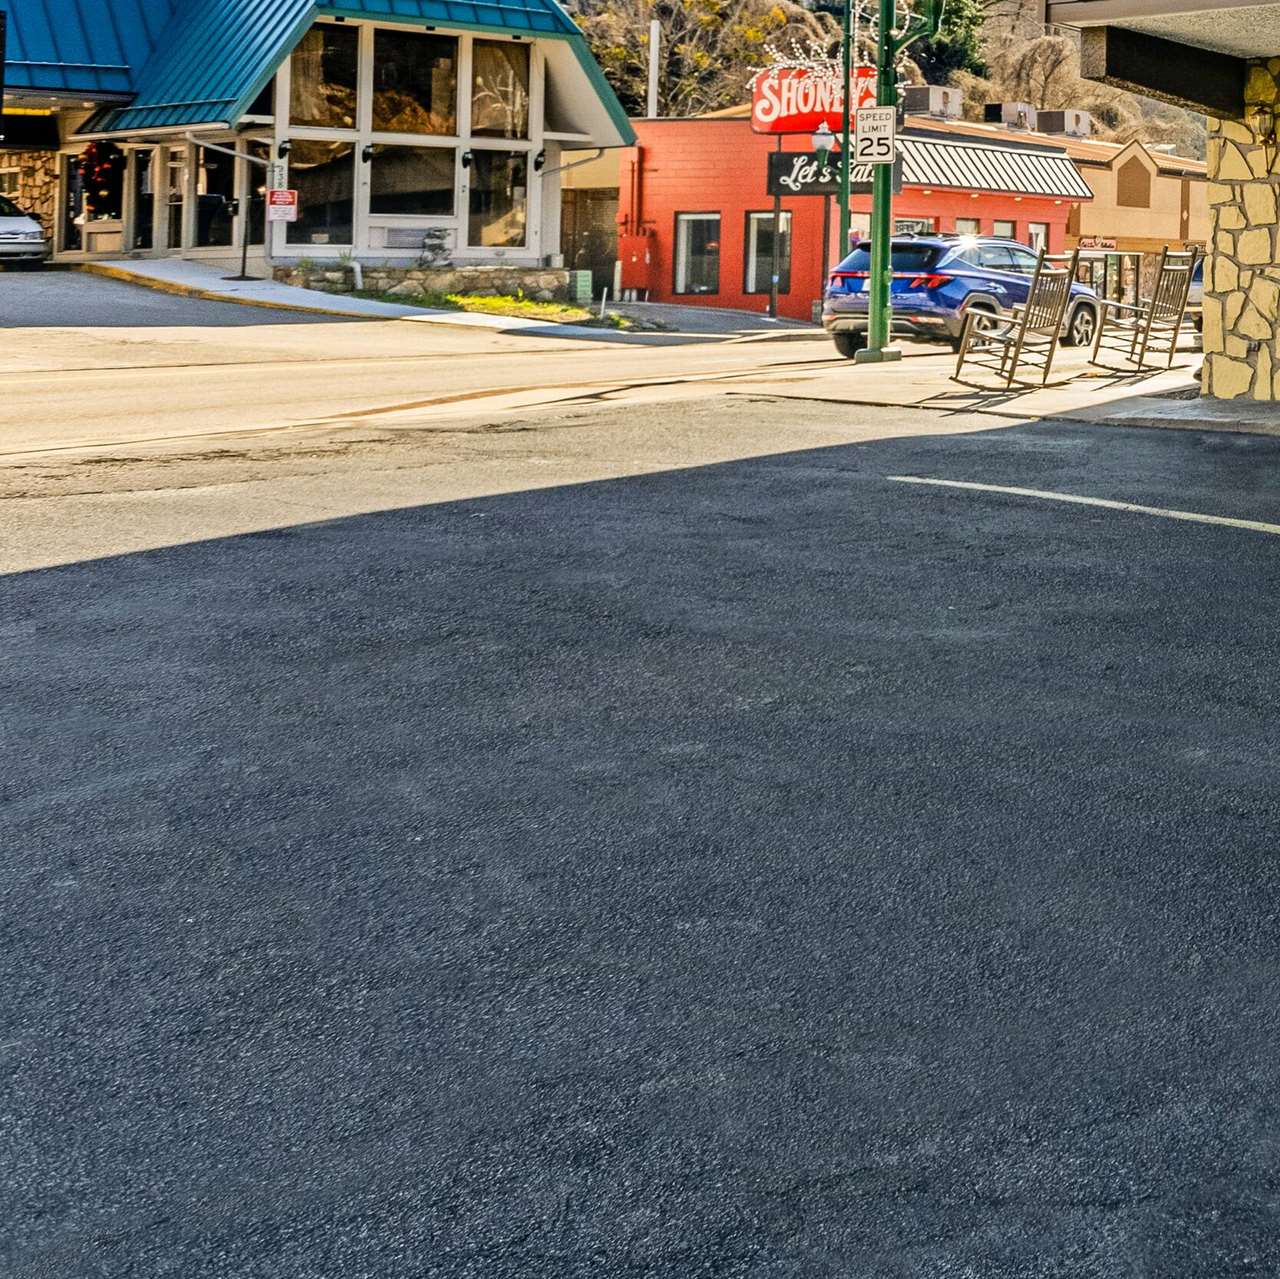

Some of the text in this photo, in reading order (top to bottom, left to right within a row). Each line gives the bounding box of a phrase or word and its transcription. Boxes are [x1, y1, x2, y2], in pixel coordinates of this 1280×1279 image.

[859, 112, 892, 122] SPEED
[862, 124, 888, 133] LIMIT
[859, 137, 891, 157] 25
